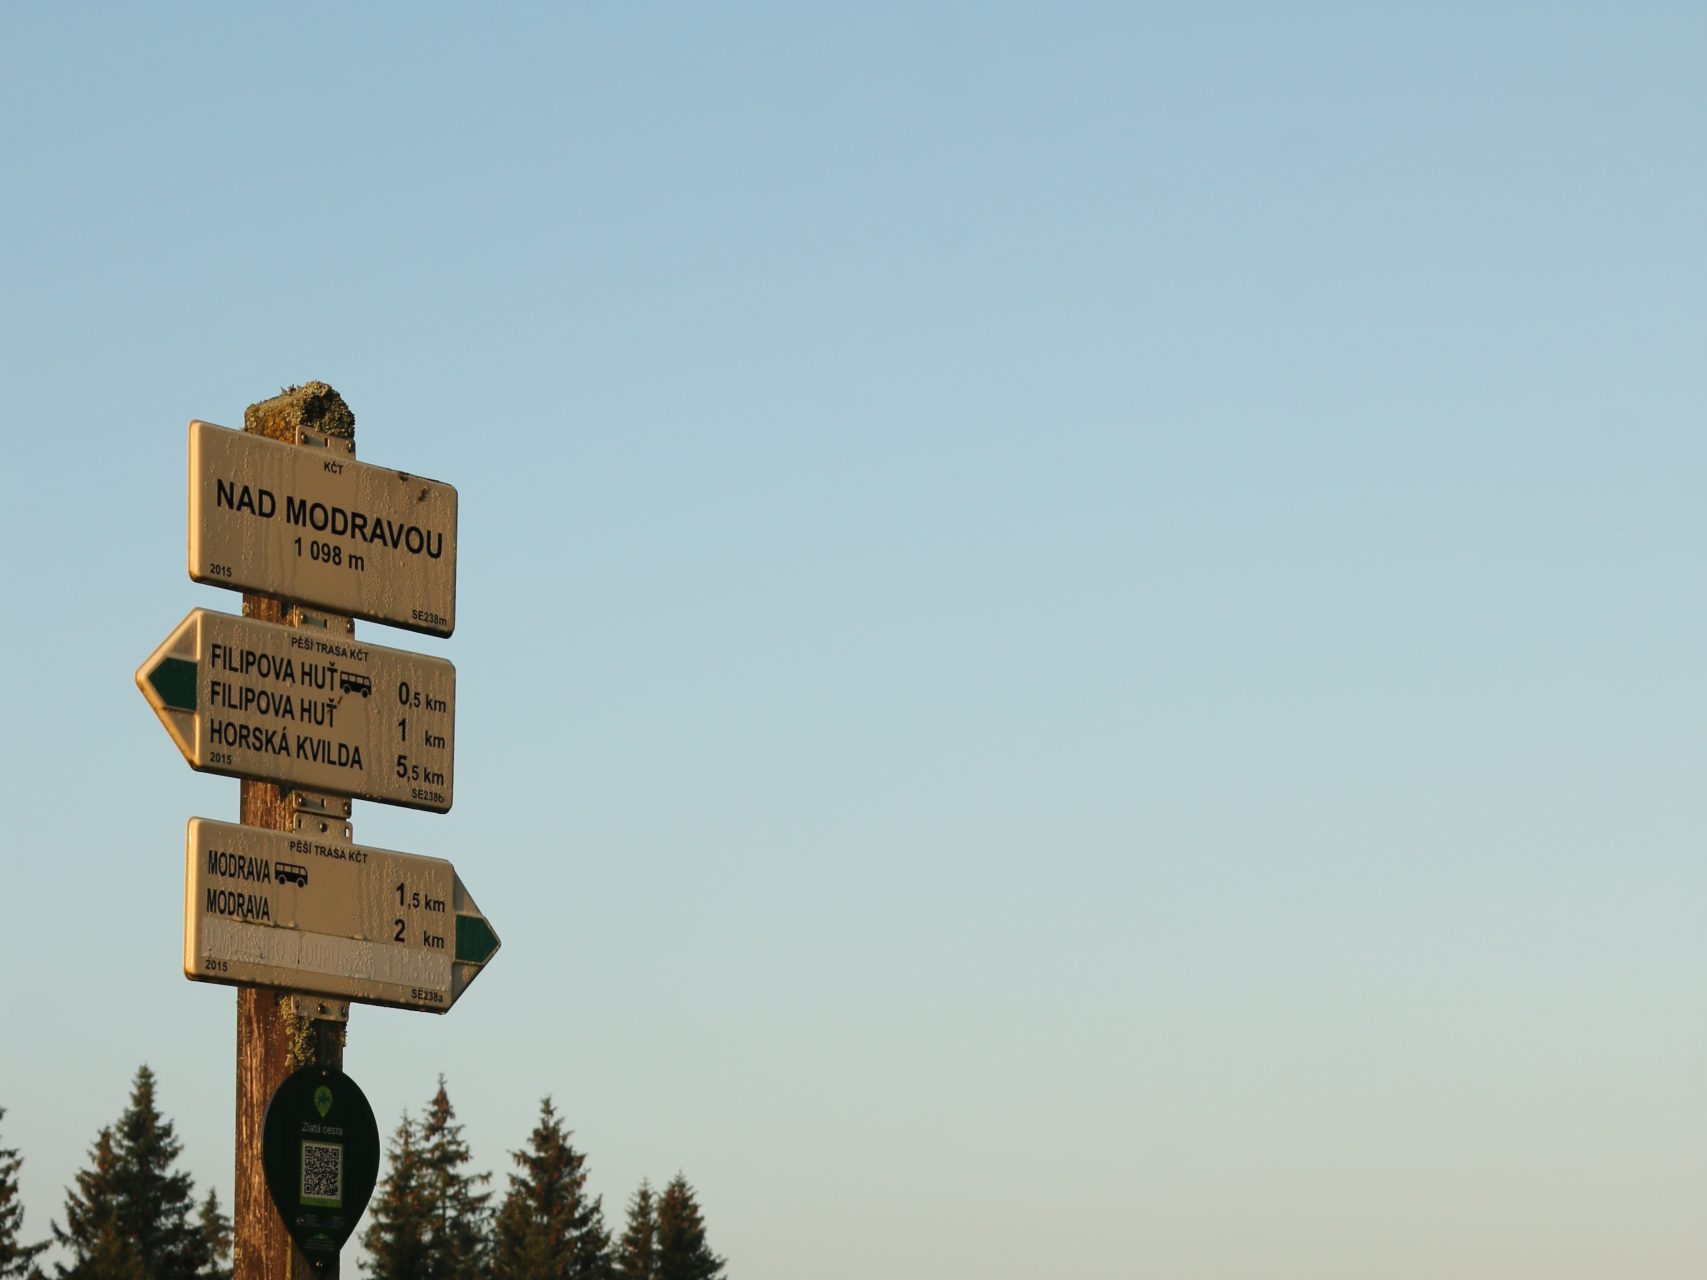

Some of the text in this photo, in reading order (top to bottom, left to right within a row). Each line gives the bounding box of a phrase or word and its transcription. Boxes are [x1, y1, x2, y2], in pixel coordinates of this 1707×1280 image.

[324, 461, 344, 475] KČT
[216, 478, 443, 559] NAD MODRAVOU
[294, 537, 365, 571] 1 098 m
[210, 563, 232, 577] 2015
[412, 609, 447, 626] SE238m
[211, 643, 338, 691] FILIPOVA HUŤ
[315, 642, 348, 659] TRASA
[350, 648, 370, 662] KČT
[210, 680, 336, 727] FILIPOVA HUŤ
[398, 681, 447, 713] 0,5 km
[210, 718, 363, 770] HORSKÁ KVILDA
[398, 718, 446, 749] 1 km
[210, 752, 232, 765] 2015
[396, 755, 444, 786] 5,5 km
[411, 788, 445, 803] SE238b
[208, 850, 271, 884] MODRAVA
[290, 840, 368, 864] PĚŠÍ TRASA KČT
[207, 888, 270, 920] MODRAVA
[395, 883, 446, 913] 1,5 km
[393, 919, 445, 949] 2 km
[205, 960, 228, 973] 2015
[411, 988, 443, 1003] SE238a
